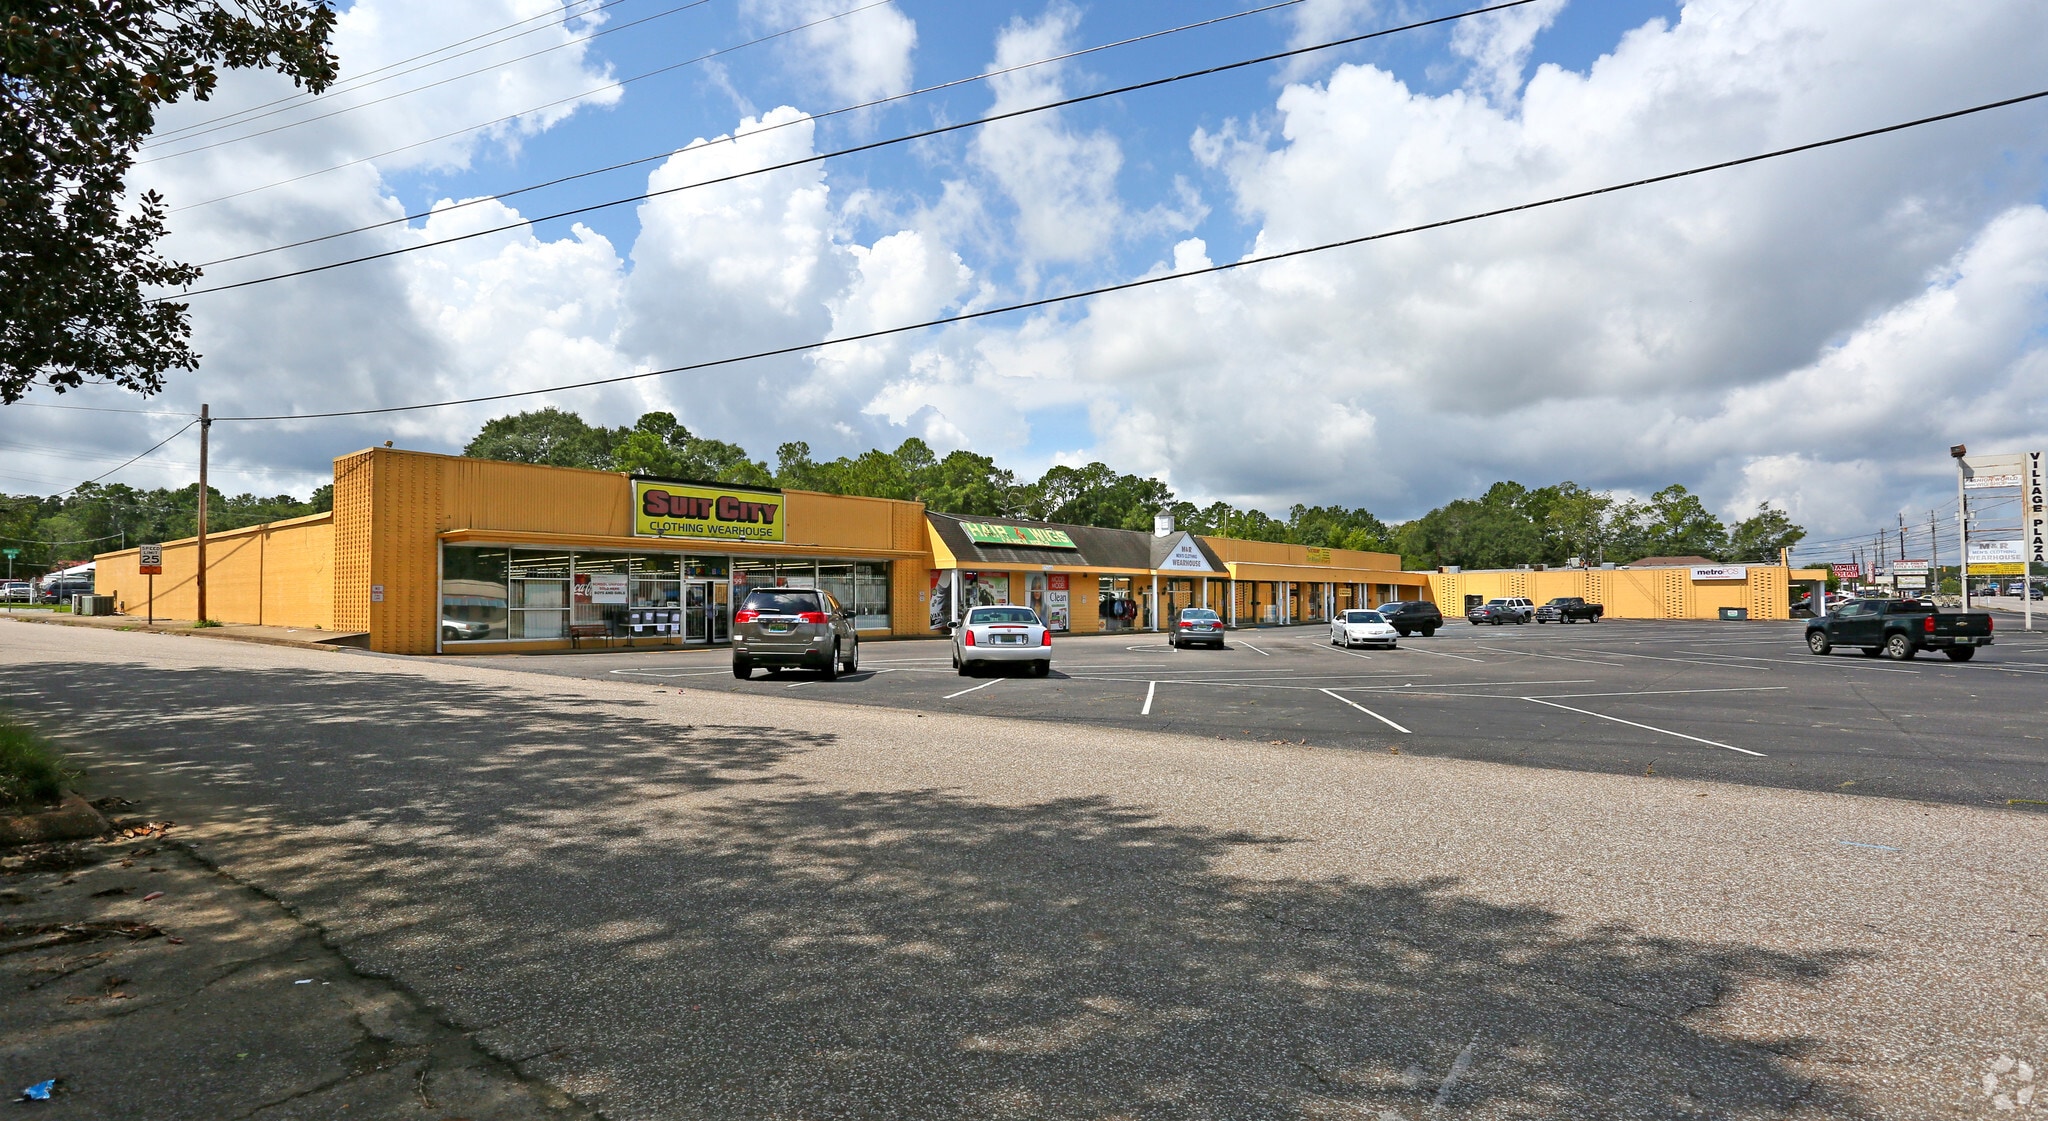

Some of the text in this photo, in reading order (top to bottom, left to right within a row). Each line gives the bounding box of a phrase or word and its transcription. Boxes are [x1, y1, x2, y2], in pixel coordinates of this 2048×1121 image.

[2030, 452, 2043, 513] VILLAGE
[650, 521, 773, 536] CLOTHING WEARHOUSE
[1026, 528, 1069, 543] WIGS
[2033, 519, 2044, 562] PLAZA
[142, 555, 159, 563] 25
[1172, 559, 1201, 567] WEARHOUSE
[1050, 592, 1066, 602] Clean
